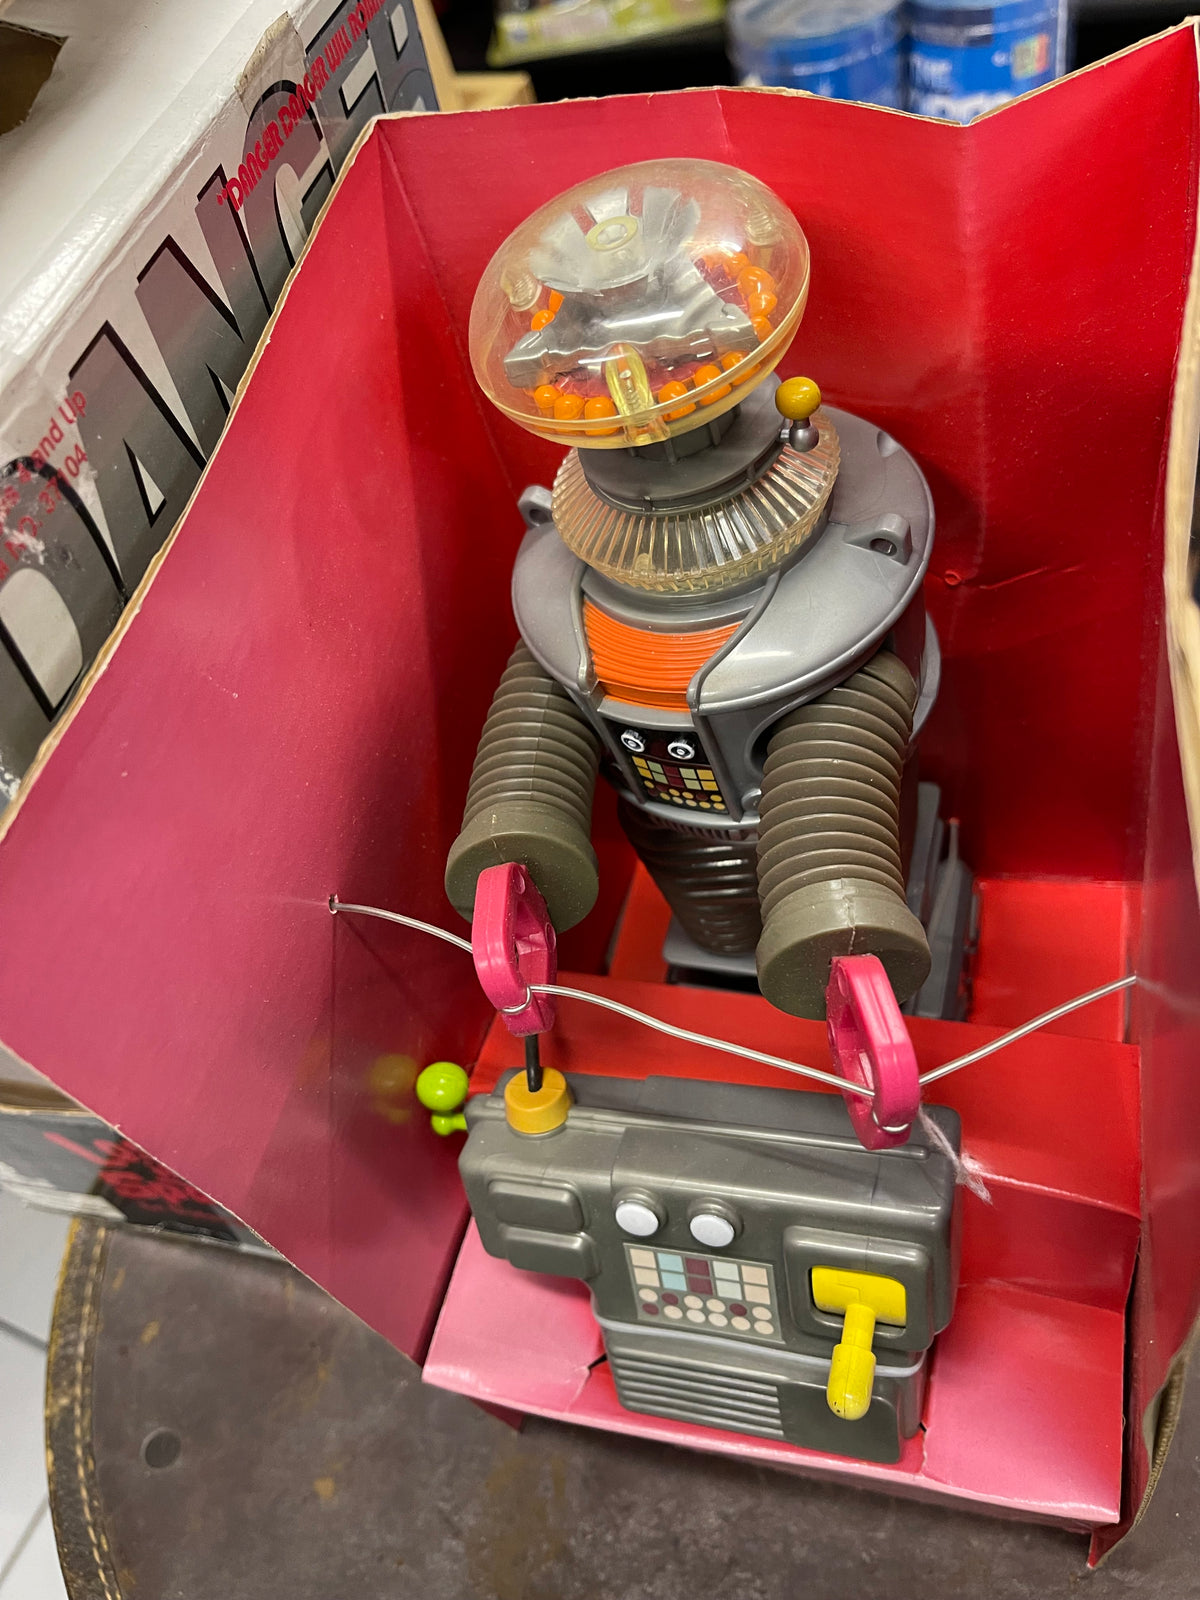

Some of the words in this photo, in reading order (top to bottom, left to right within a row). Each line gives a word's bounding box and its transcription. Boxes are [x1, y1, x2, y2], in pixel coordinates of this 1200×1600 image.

[278, 56, 330, 139] DANGER
[323, 24, 353, 74] WILL
[30, 417, 65, 470] and
[58, 390, 88, 425] Up
[38, 443, 89, 515] 37104
